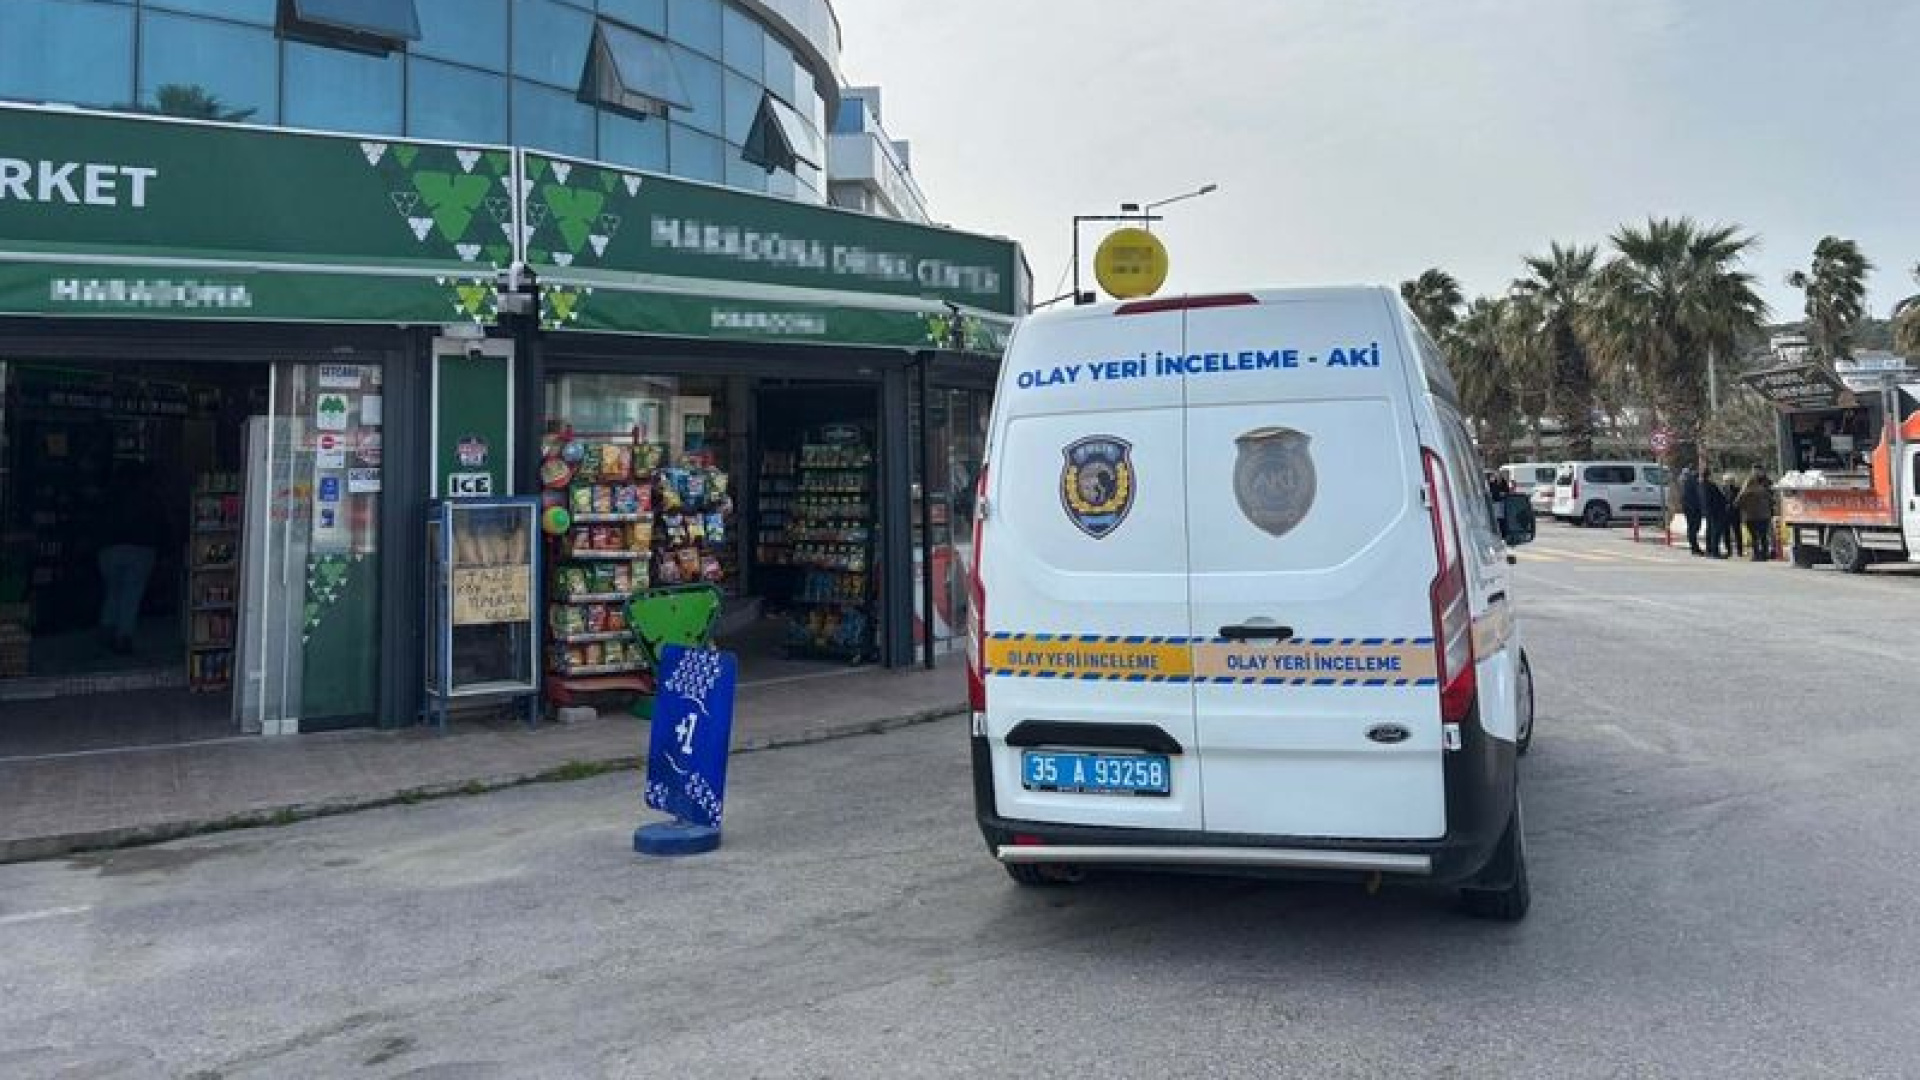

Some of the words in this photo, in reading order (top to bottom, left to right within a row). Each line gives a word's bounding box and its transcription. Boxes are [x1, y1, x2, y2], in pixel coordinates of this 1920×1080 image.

[0, 158, 158, 207] RKET
[1016, 364, 1082, 390] OLAY
[1087, 352, 1148, 381] YERİ
[1155, 349, 1299, 377] İNCELEME
[1326, 341, 1381, 368] AKİ
[452, 477, 489, 493] ICE
[1008, 650, 1042, 666] OLAY
[1227, 654, 1267, 670] OLAY
[1273, 651, 1311, 671] YERİ
[1314, 651, 1402, 672] İNCELEME
[1031, 756, 1059, 781] 35
[1073, 757, 1085, 783] A
[1094, 759, 1163, 786] 93258
